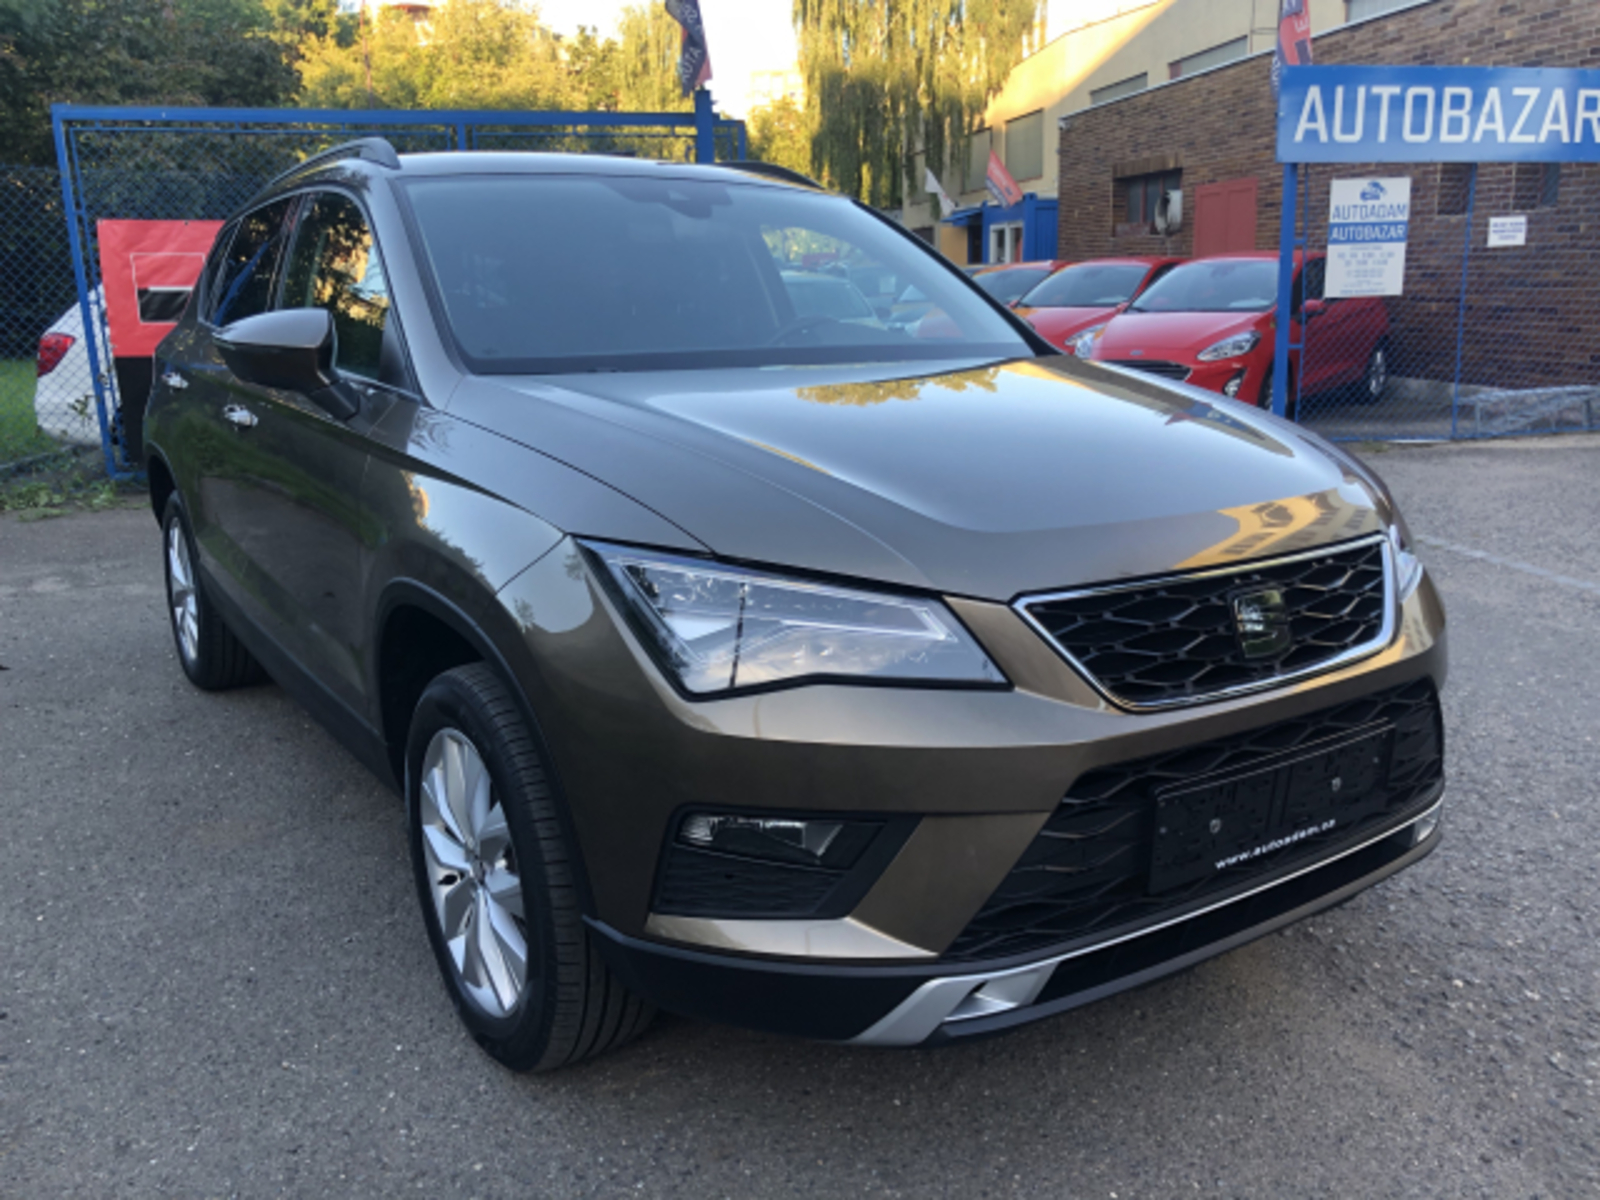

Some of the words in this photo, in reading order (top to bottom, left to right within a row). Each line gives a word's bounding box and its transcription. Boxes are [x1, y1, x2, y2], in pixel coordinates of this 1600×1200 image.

[1293, 84, 1600, 144] AUTOBAZAR
[1332, 203, 1407, 221] AUTOADAM
[1330, 224, 1405, 241] AUTOBAZAR
